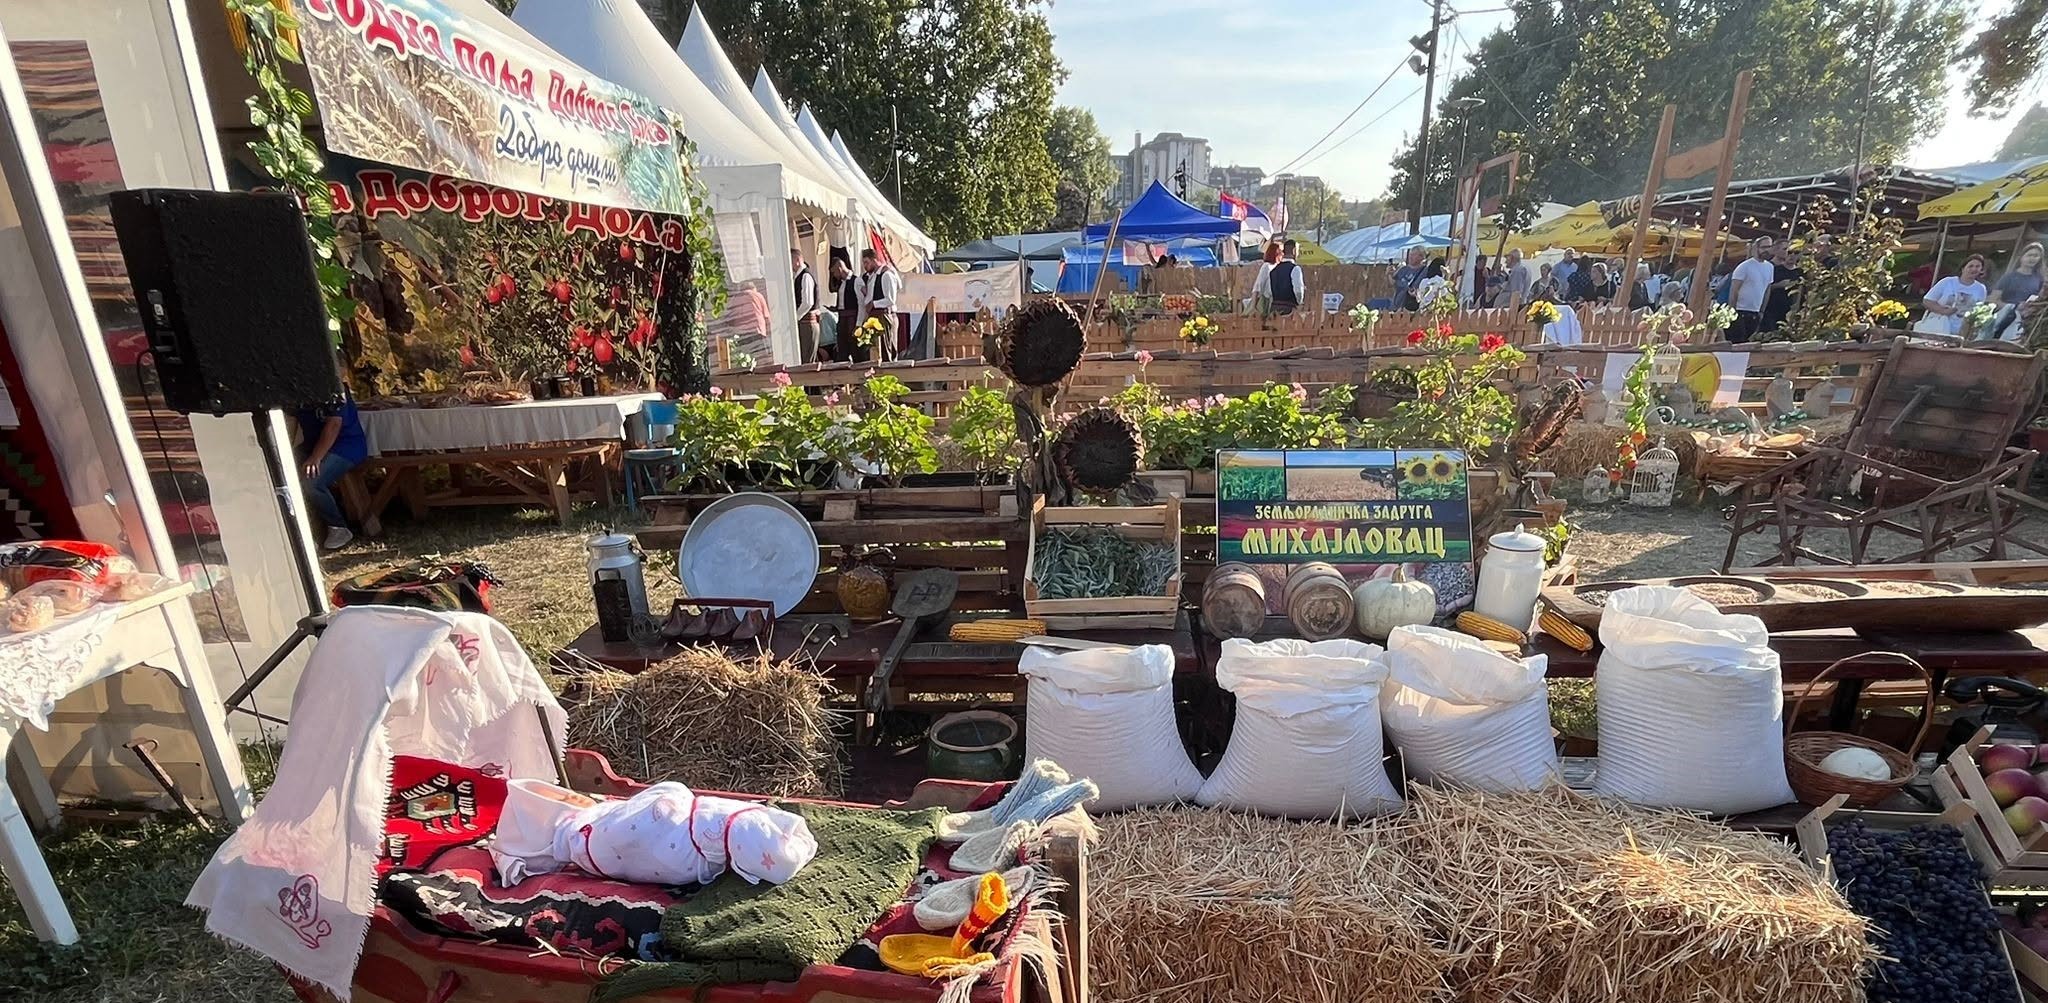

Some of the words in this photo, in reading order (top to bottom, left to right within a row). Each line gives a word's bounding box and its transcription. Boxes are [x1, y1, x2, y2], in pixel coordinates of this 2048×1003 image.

[305, 0, 454, 60] одна
[452, 34, 537, 105] поља
[546, 68, 625, 134] Доброг
[495, 103, 564, 184] Добро
[566, 146, 619, 190] дошли
[356, 169, 554, 222] Доброг
[564, 205, 686, 253] Дола
[1240, 526, 1448, 560] МИХАЈЛОВАЦ
[1254, 504, 1370, 521] ЗЕМЉОРАДНИЧКА
[1372, 504, 1434, 521] ЗАДРУГА
